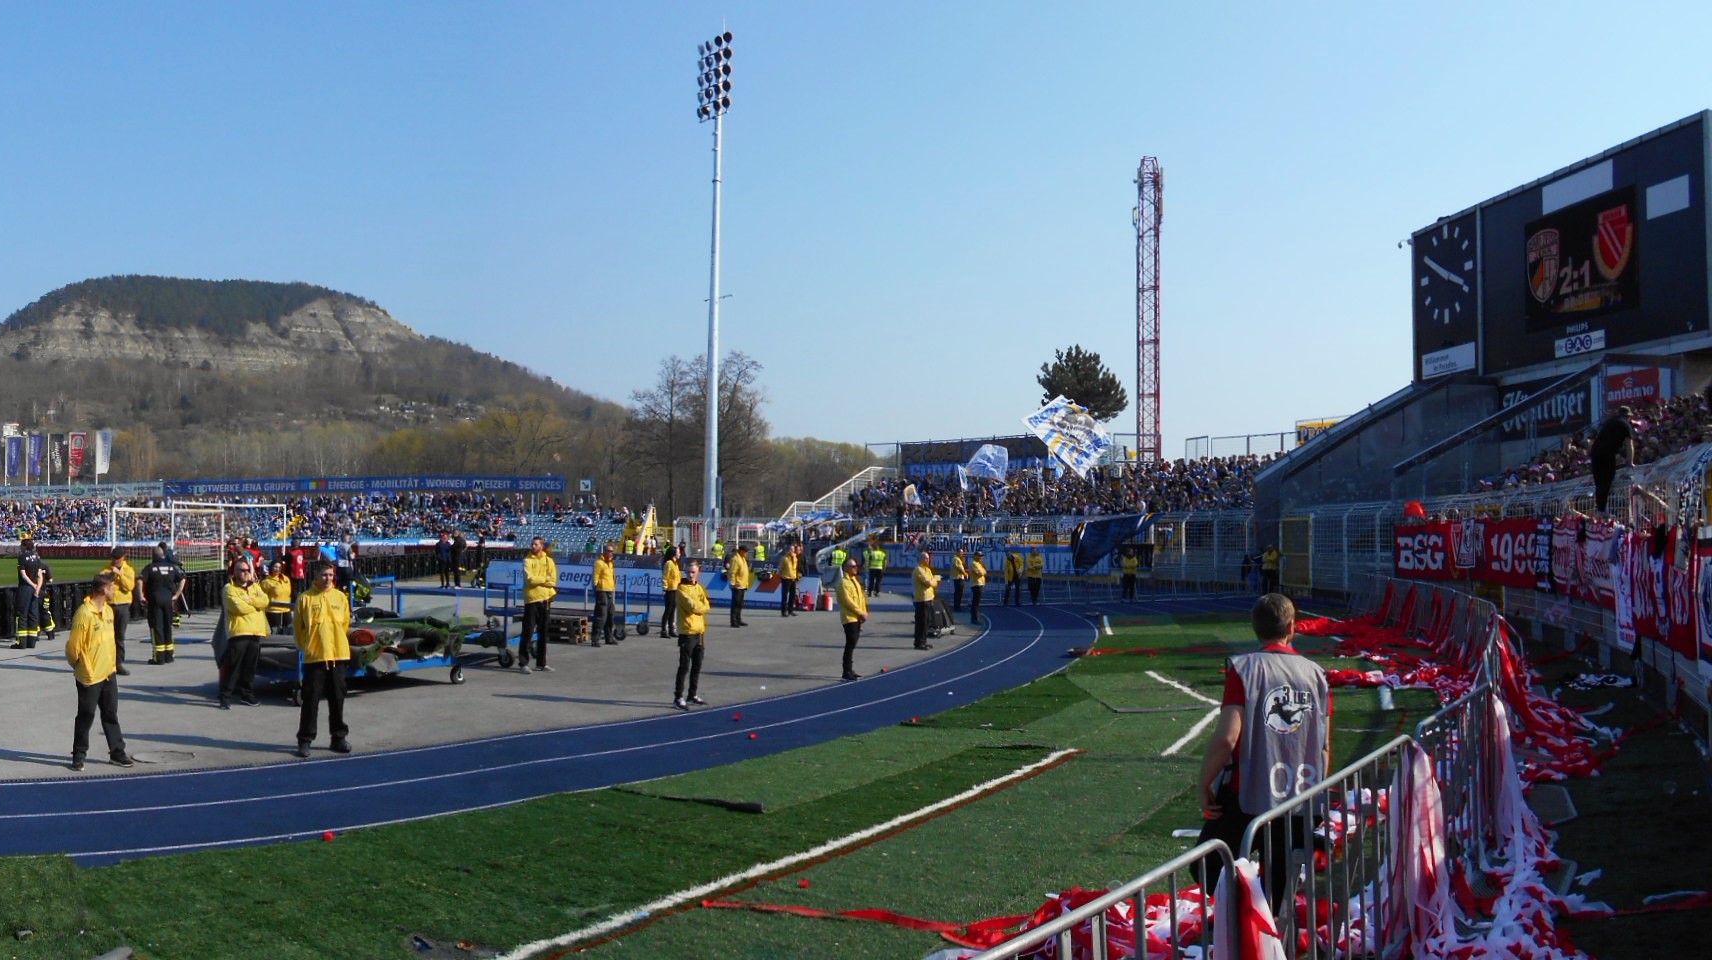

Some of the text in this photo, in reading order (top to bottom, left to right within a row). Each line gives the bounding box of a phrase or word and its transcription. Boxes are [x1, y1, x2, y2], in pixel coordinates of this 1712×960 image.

[1559, 259, 1591, 295] 2:1
[1566, 321, 1589, 335] PHILIPS
[1565, 335, 1592, 353] EAG
[1502, 389, 1587, 433] Kötritzer
[187, 477, 561, 494] SDTWERKE JENA GRUPPE ENERGIE MOBILITÄT WOHNEN EIZEIT SERVICES
[474, 481, 484, 490] M
[1397, 535, 1444, 571] BSG
[560, 572, 592, 587] energ
[1269, 761, 1318, 799] 08
